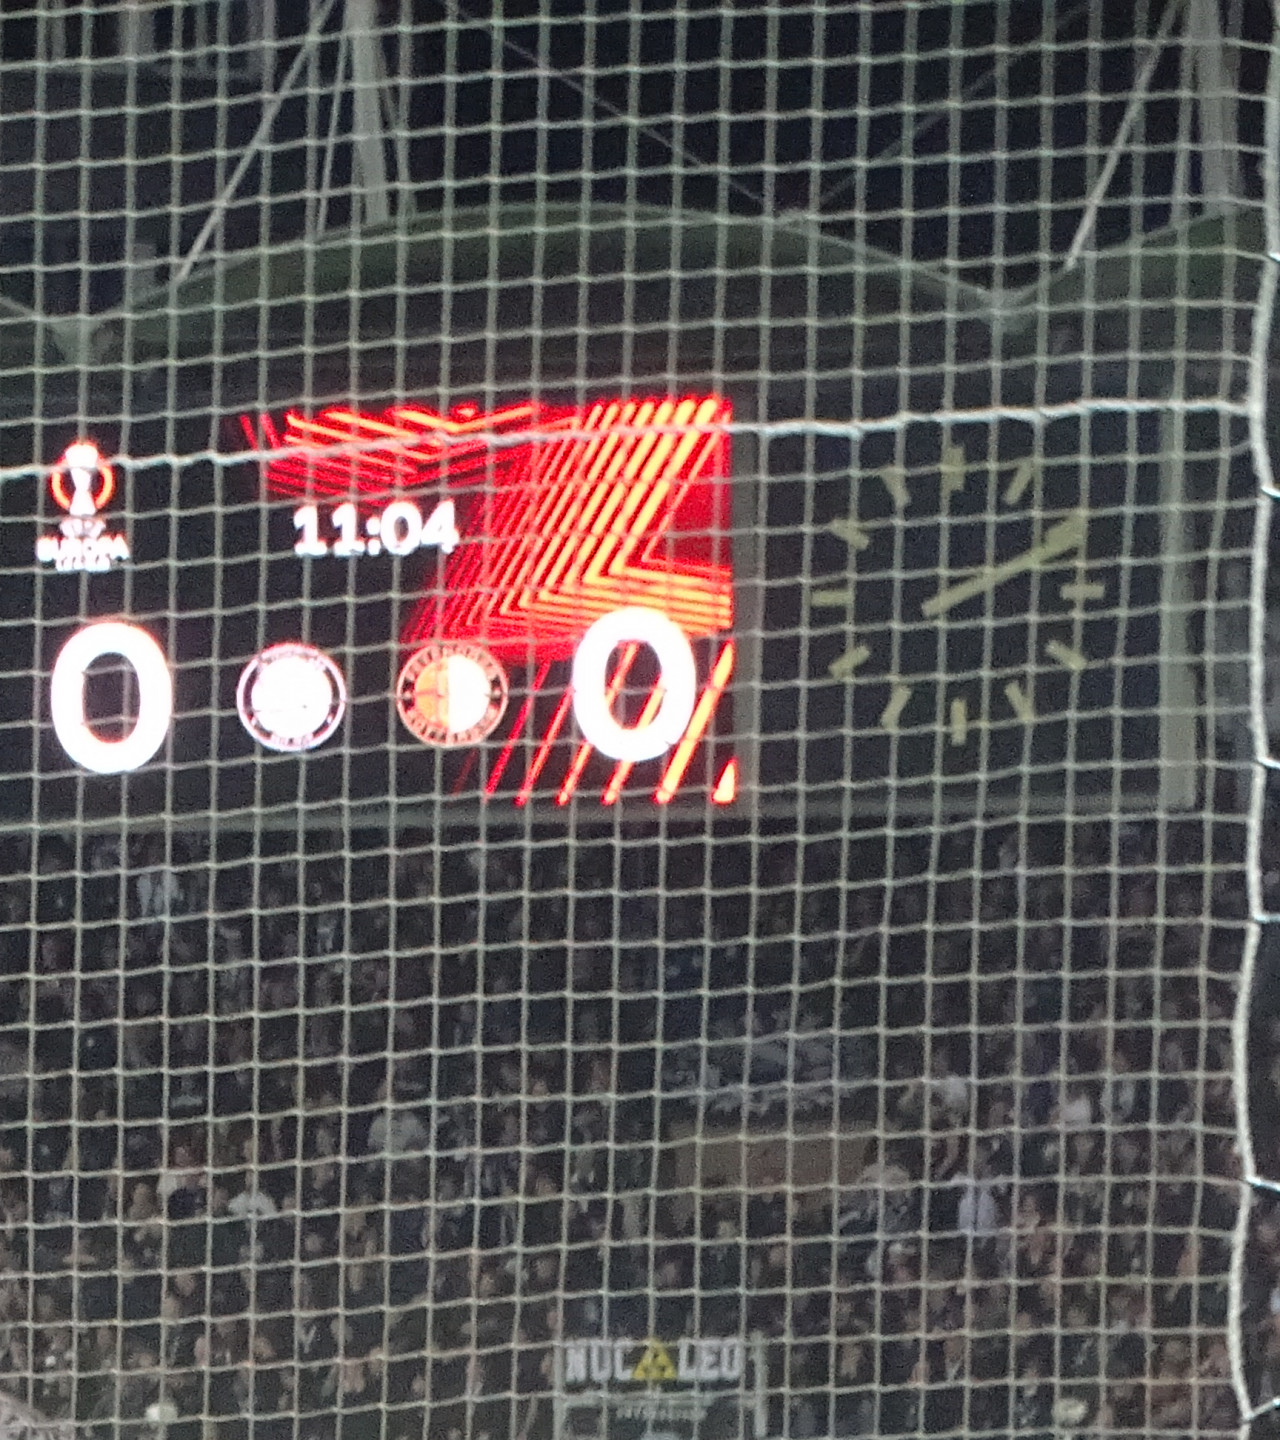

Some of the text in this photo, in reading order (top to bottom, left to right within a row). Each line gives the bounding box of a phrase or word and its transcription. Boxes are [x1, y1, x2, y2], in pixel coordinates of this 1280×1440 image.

[293, 498, 460, 557] 11:04
[50, 622, 172, 774] 0
[572, 606, 696, 762] 0
